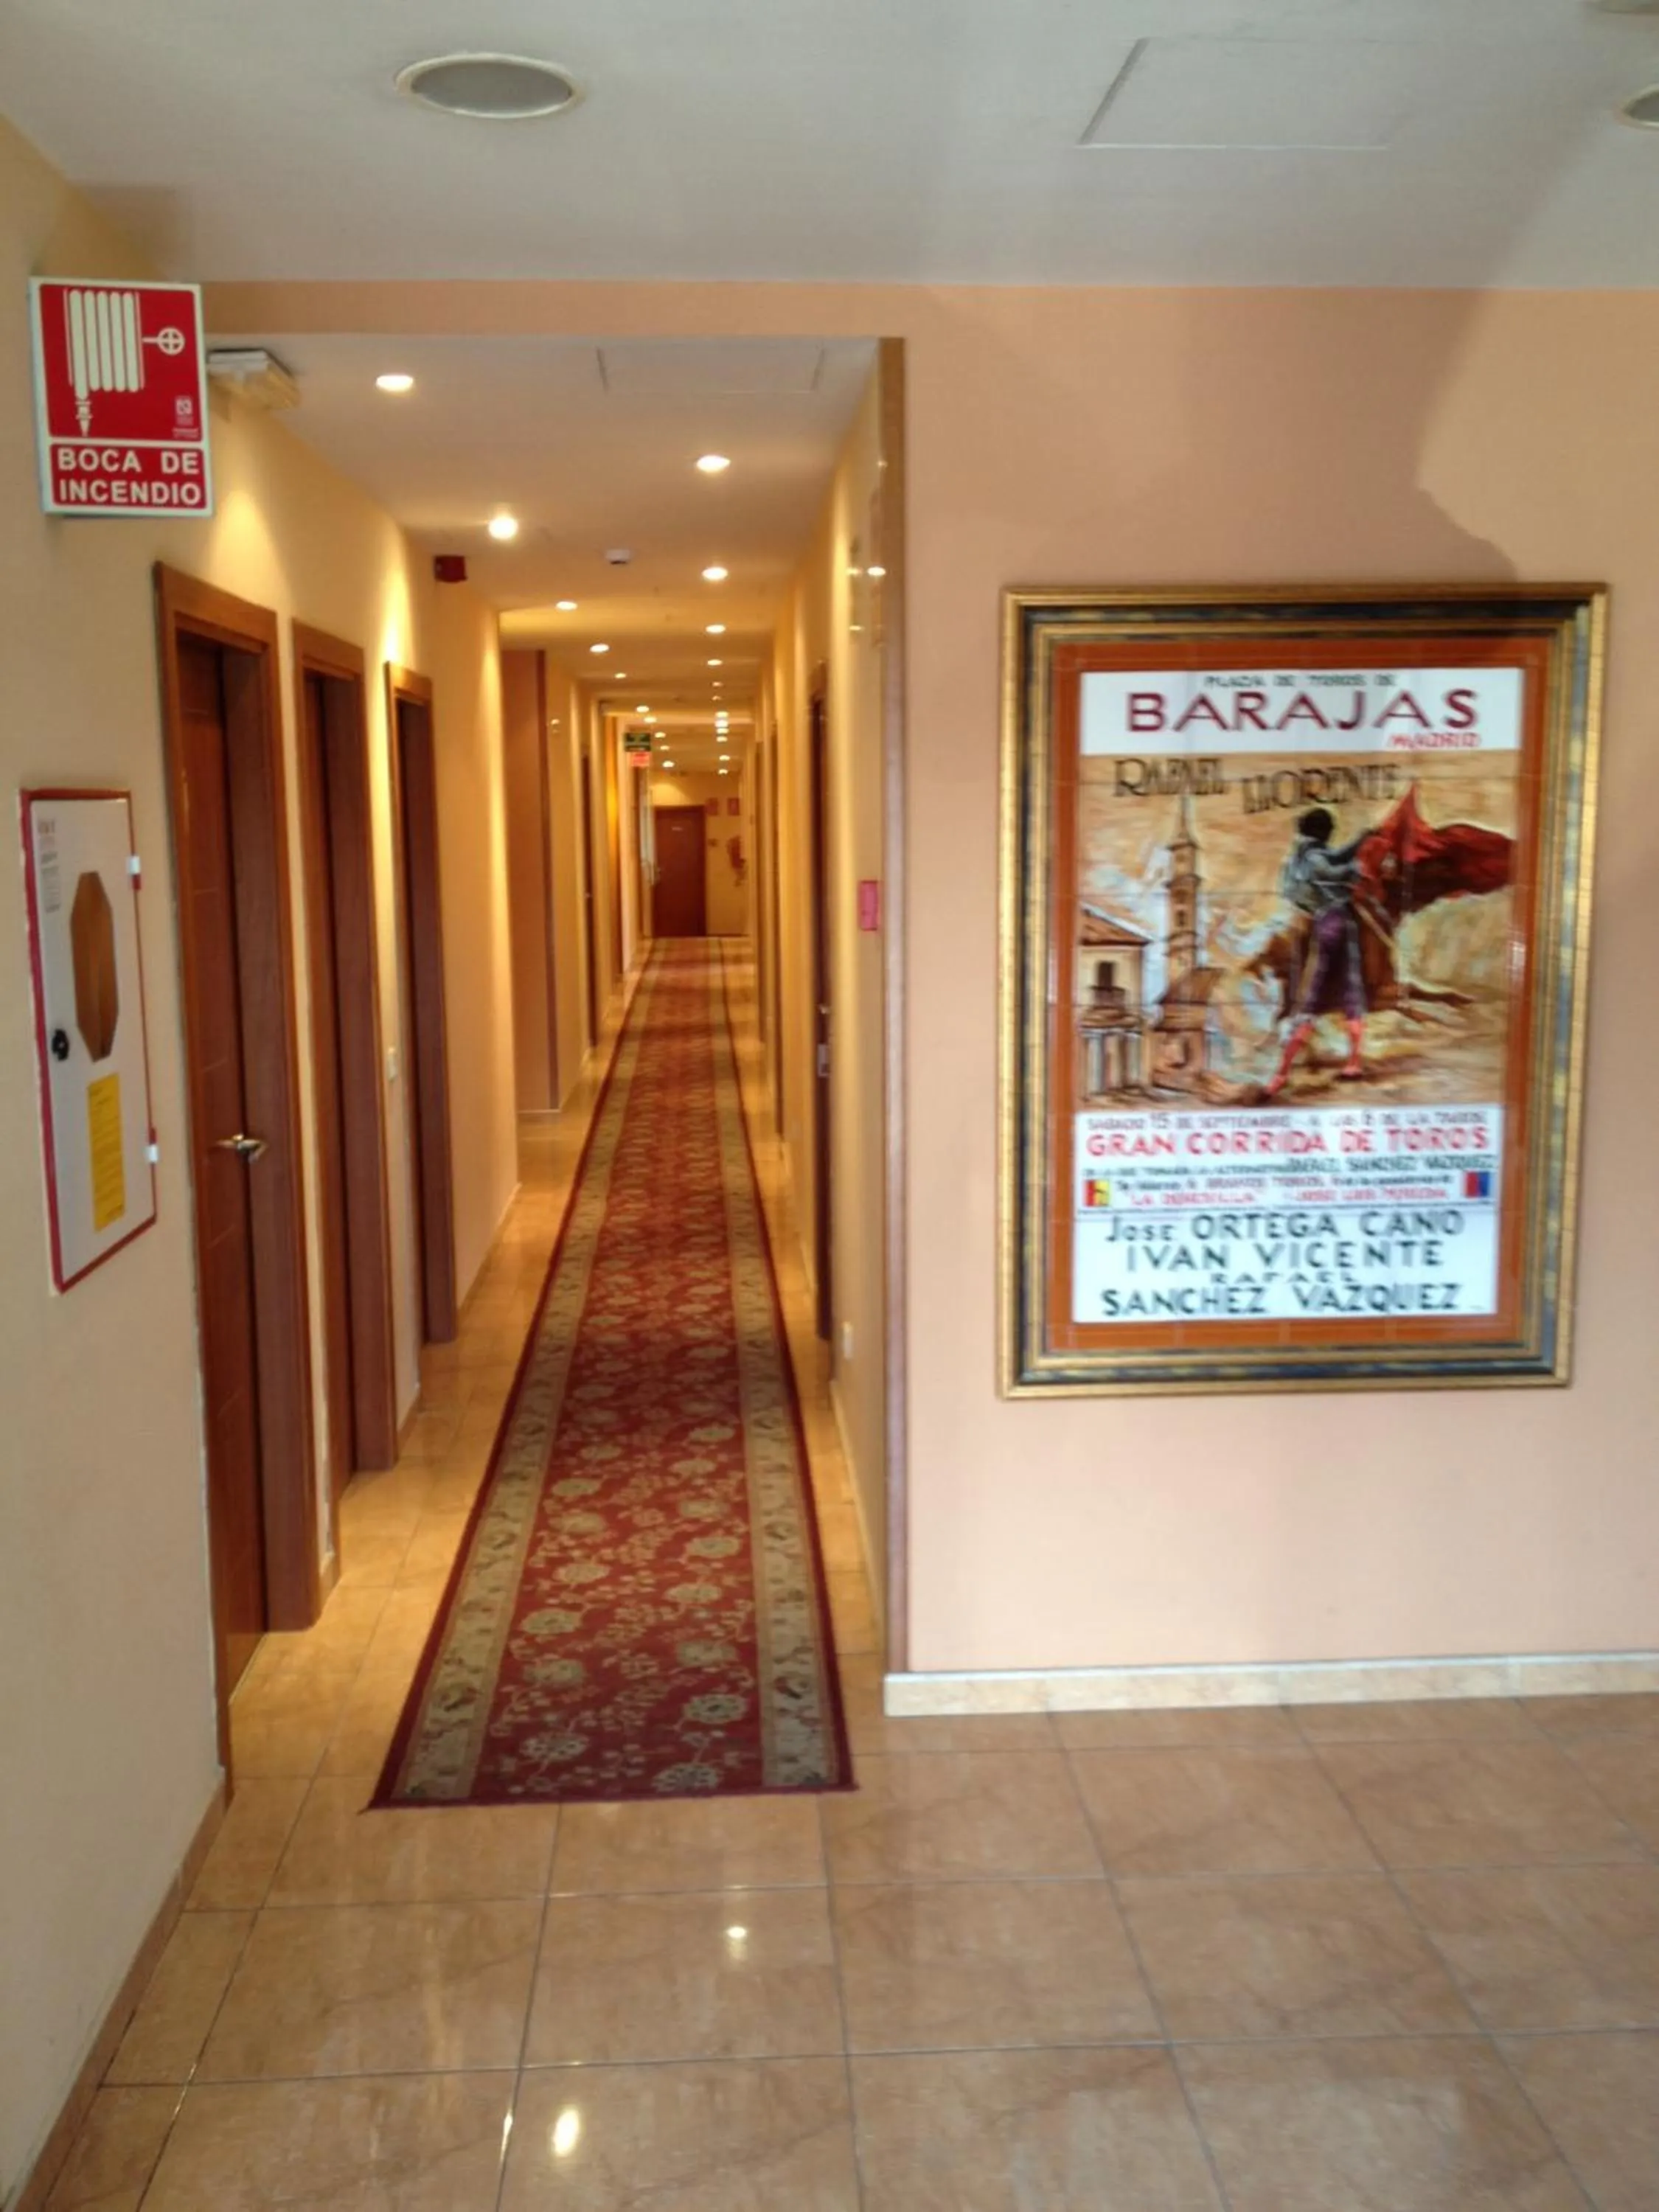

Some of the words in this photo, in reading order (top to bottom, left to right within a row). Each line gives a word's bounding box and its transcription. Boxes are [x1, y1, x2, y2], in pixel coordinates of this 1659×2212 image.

[58, 448, 141, 472] BOCA
[161, 451, 199, 474] DE
[60, 479, 201, 504] INCENDIO
[1127, 689, 1480, 733] BARAJAS
[1086, 1133, 1175, 1156] GRAN
[1186, 1130, 1326, 1155] CORRIDA
[1340, 1128, 1374, 1153] DE
[1386, 1126, 1488, 1150] TOROS
[1192, 1211, 1340, 1240] ORTEGA
[1359, 1208, 1466, 1235] CANO
[1127, 1243, 1229, 1272] IVAN
[1253, 1239, 1444, 1269] VICENTE
[1210, 1270, 1356, 1284] RAFAEL
[1102, 1287, 1267, 1316] SANCHEZ
[1292, 1281, 1463, 1312] VAZQUEZ
